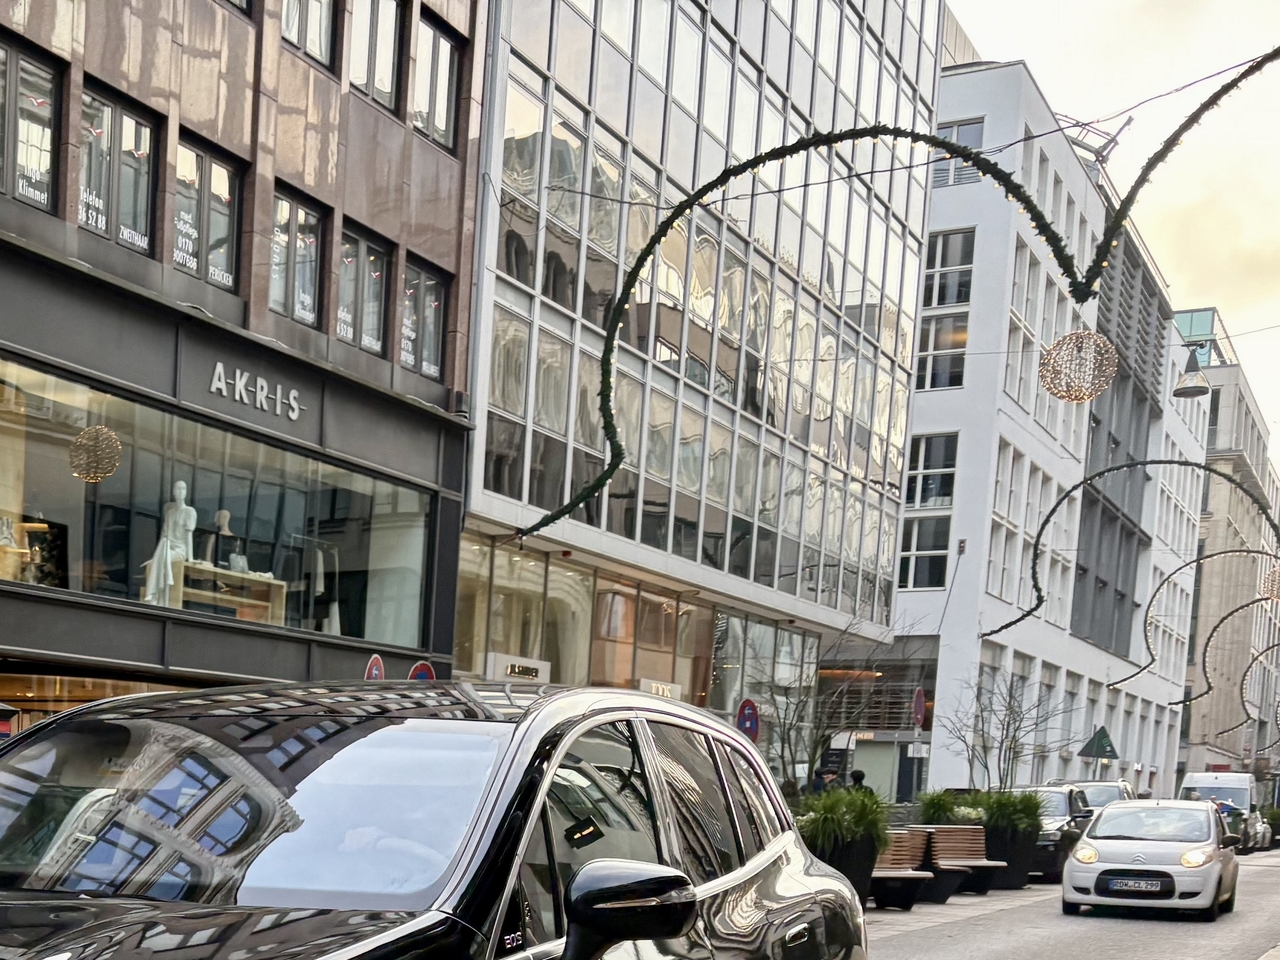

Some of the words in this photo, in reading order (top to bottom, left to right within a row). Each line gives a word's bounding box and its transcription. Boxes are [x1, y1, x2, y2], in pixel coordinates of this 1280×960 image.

[18, 179, 48, 204] Klimmet
[80, 186, 103, 210] Telefon
[88, 209, 97, 226] 52
[98, 214, 106, 230] 88
[178, 235, 193, 253] 0170
